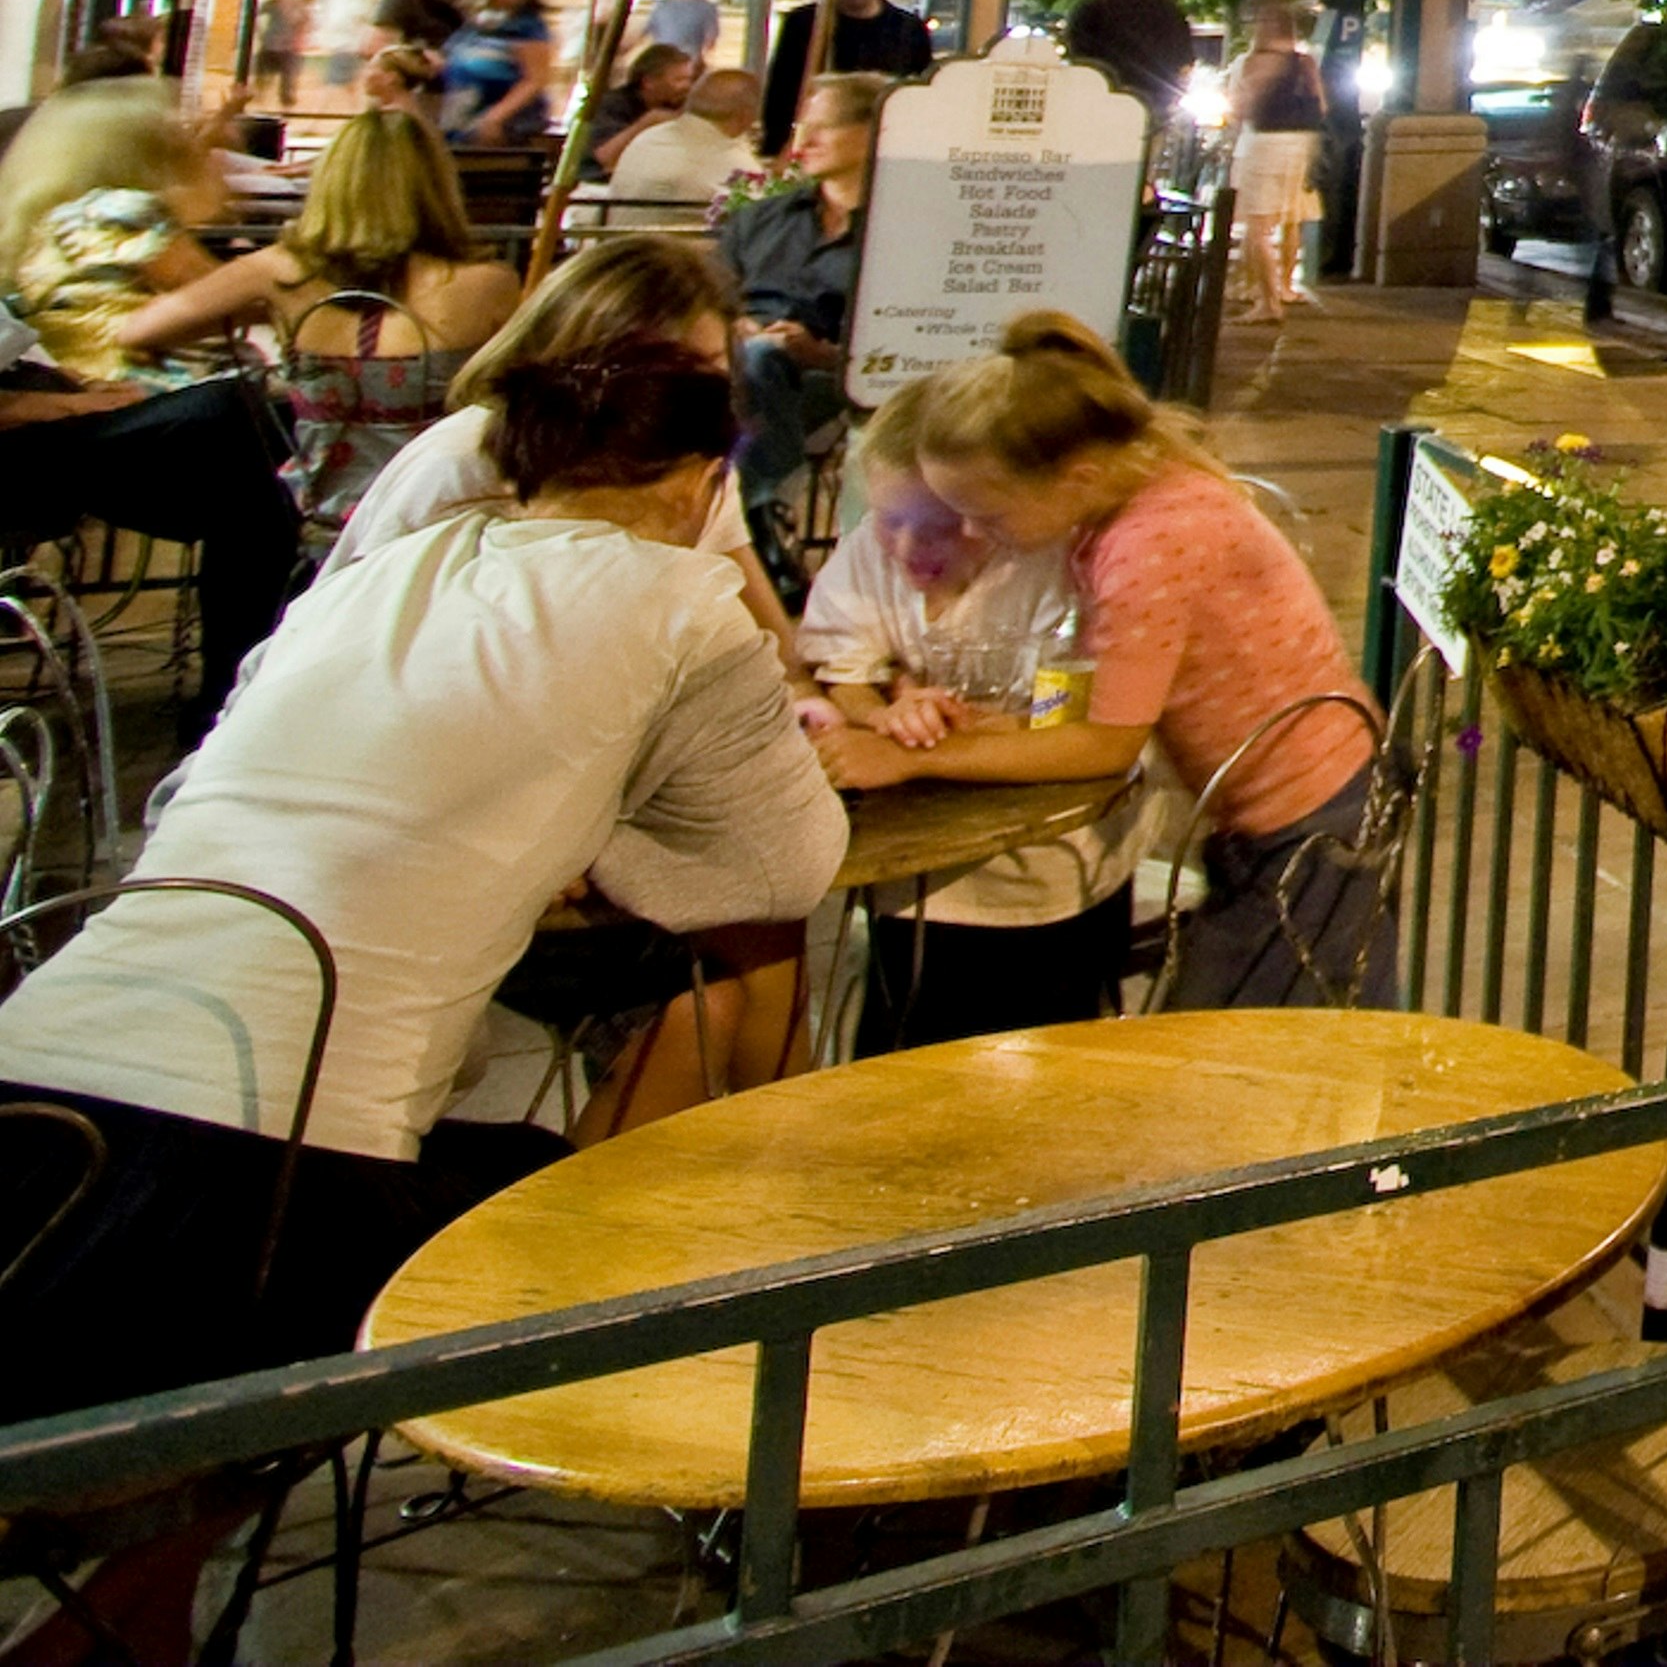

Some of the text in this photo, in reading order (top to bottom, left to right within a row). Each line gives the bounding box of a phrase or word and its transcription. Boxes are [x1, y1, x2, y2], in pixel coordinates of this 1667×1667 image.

[948, 147, 1071, 165] Espresso Bar
[950, 166, 1065, 182] Sandwiches
[959, 185, 1052, 200] Hot Food
[969, 203, 1036, 219] Salads
[972, 223, 1031, 240] Pastry
[951, 241, 1045, 256] Breakfast
[948, 259, 1043, 275] Ice Cream
[942, 278, 1043, 293] Salad Bar
[882, 306, 957, 319] Catering
[926, 322, 977, 335] Whole
[861, 353, 898, 375] 25
[1414, 461, 1450, 528] STATE
